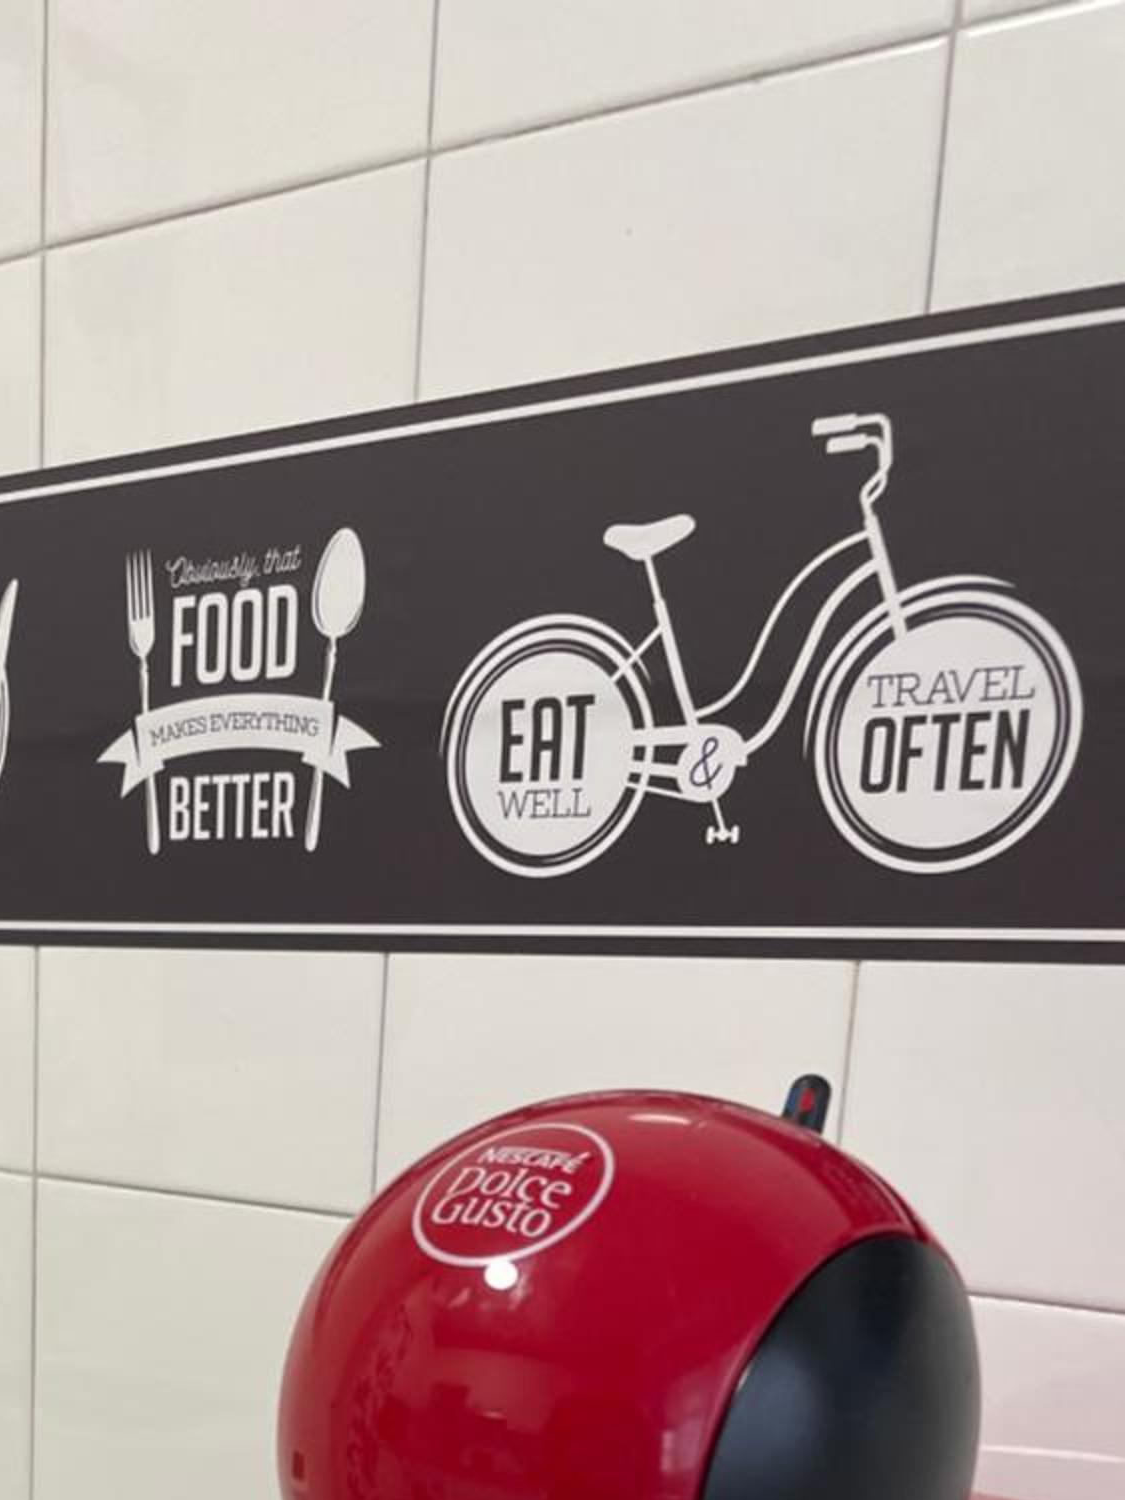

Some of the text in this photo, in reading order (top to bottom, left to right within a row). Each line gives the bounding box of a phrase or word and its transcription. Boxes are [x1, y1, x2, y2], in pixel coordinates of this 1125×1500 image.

[263, 545, 301, 574] that
[171, 584, 298, 687] FOOD
[866, 664, 1036, 709] TRAVEL
[150, 711, 319, 747] MAKES EVERYTHING
[499, 694, 596, 784] EAT
[859, 708, 1031, 795] OFTEN
[689, 735, 723, 790] &
[169, 771, 295, 841] BETTER
[497, 788, 592, 820] WELL
[477, 1147, 591, 1174] NESCAFÉ
